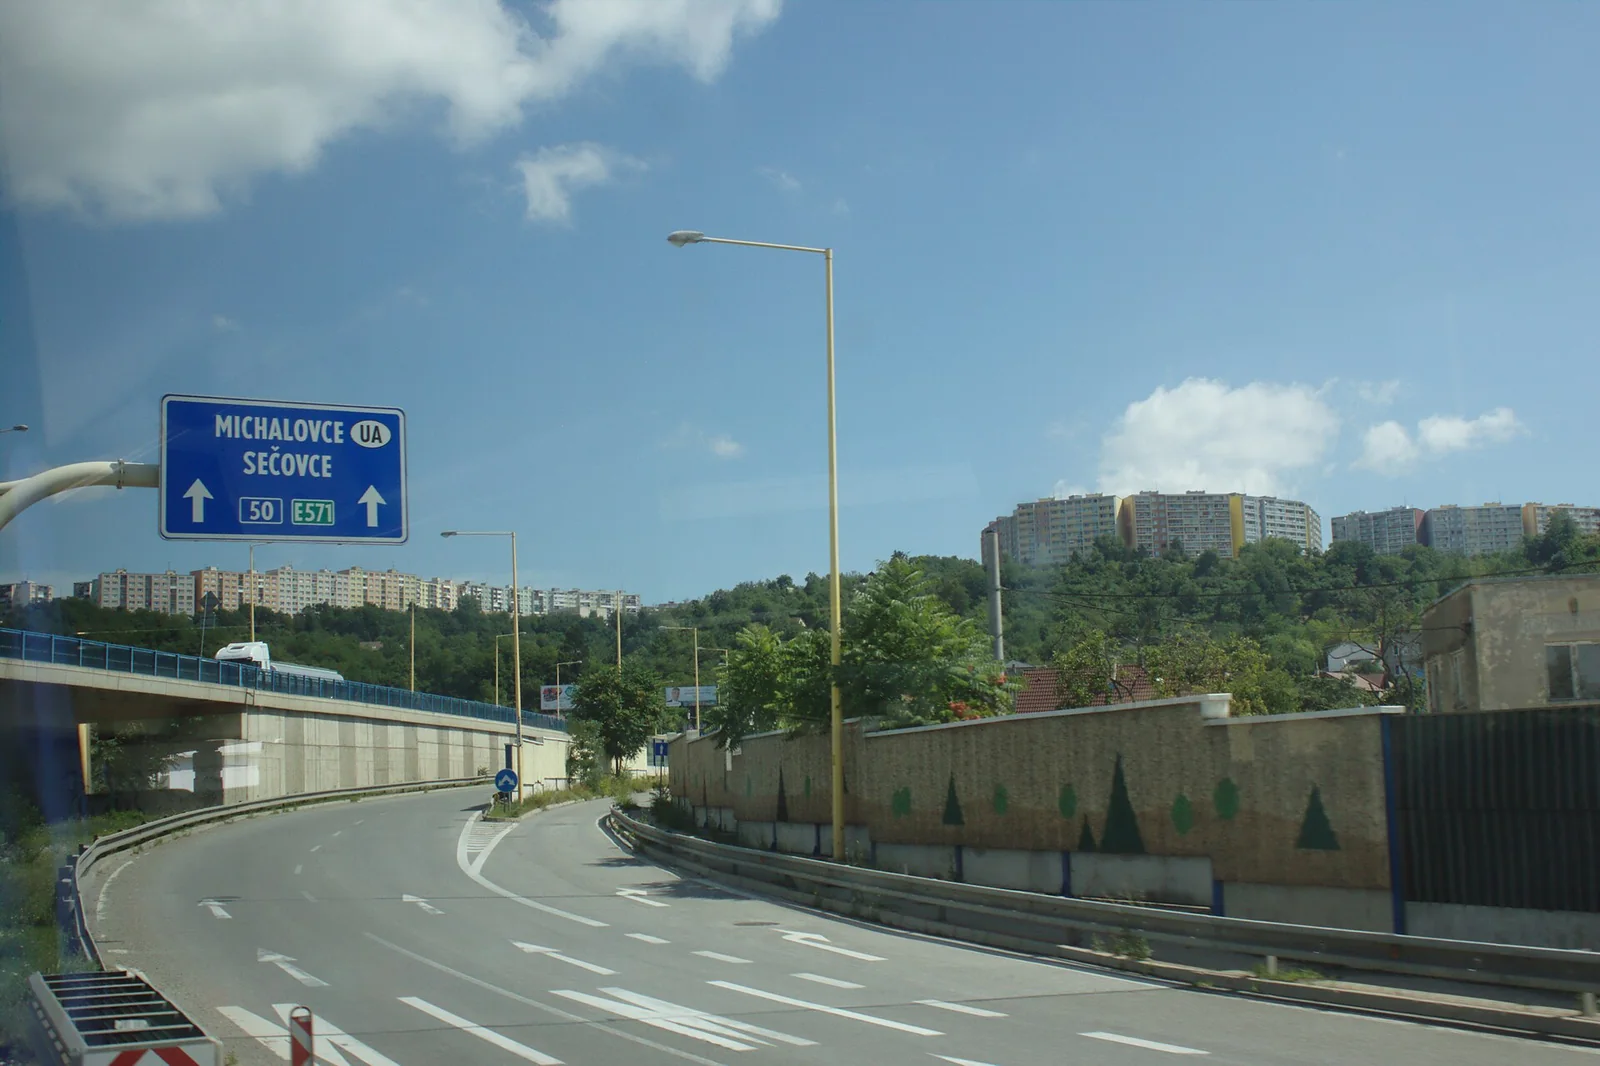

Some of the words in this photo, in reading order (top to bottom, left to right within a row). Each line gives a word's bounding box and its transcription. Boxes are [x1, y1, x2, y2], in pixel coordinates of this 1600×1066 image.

[215, 414, 344, 444] MICHALOVCE
[360, 424, 383, 444] UA
[243, 445, 332, 478] SEČOVCE
[249, 501, 274, 521] 50
[294, 502, 332, 523] E571
